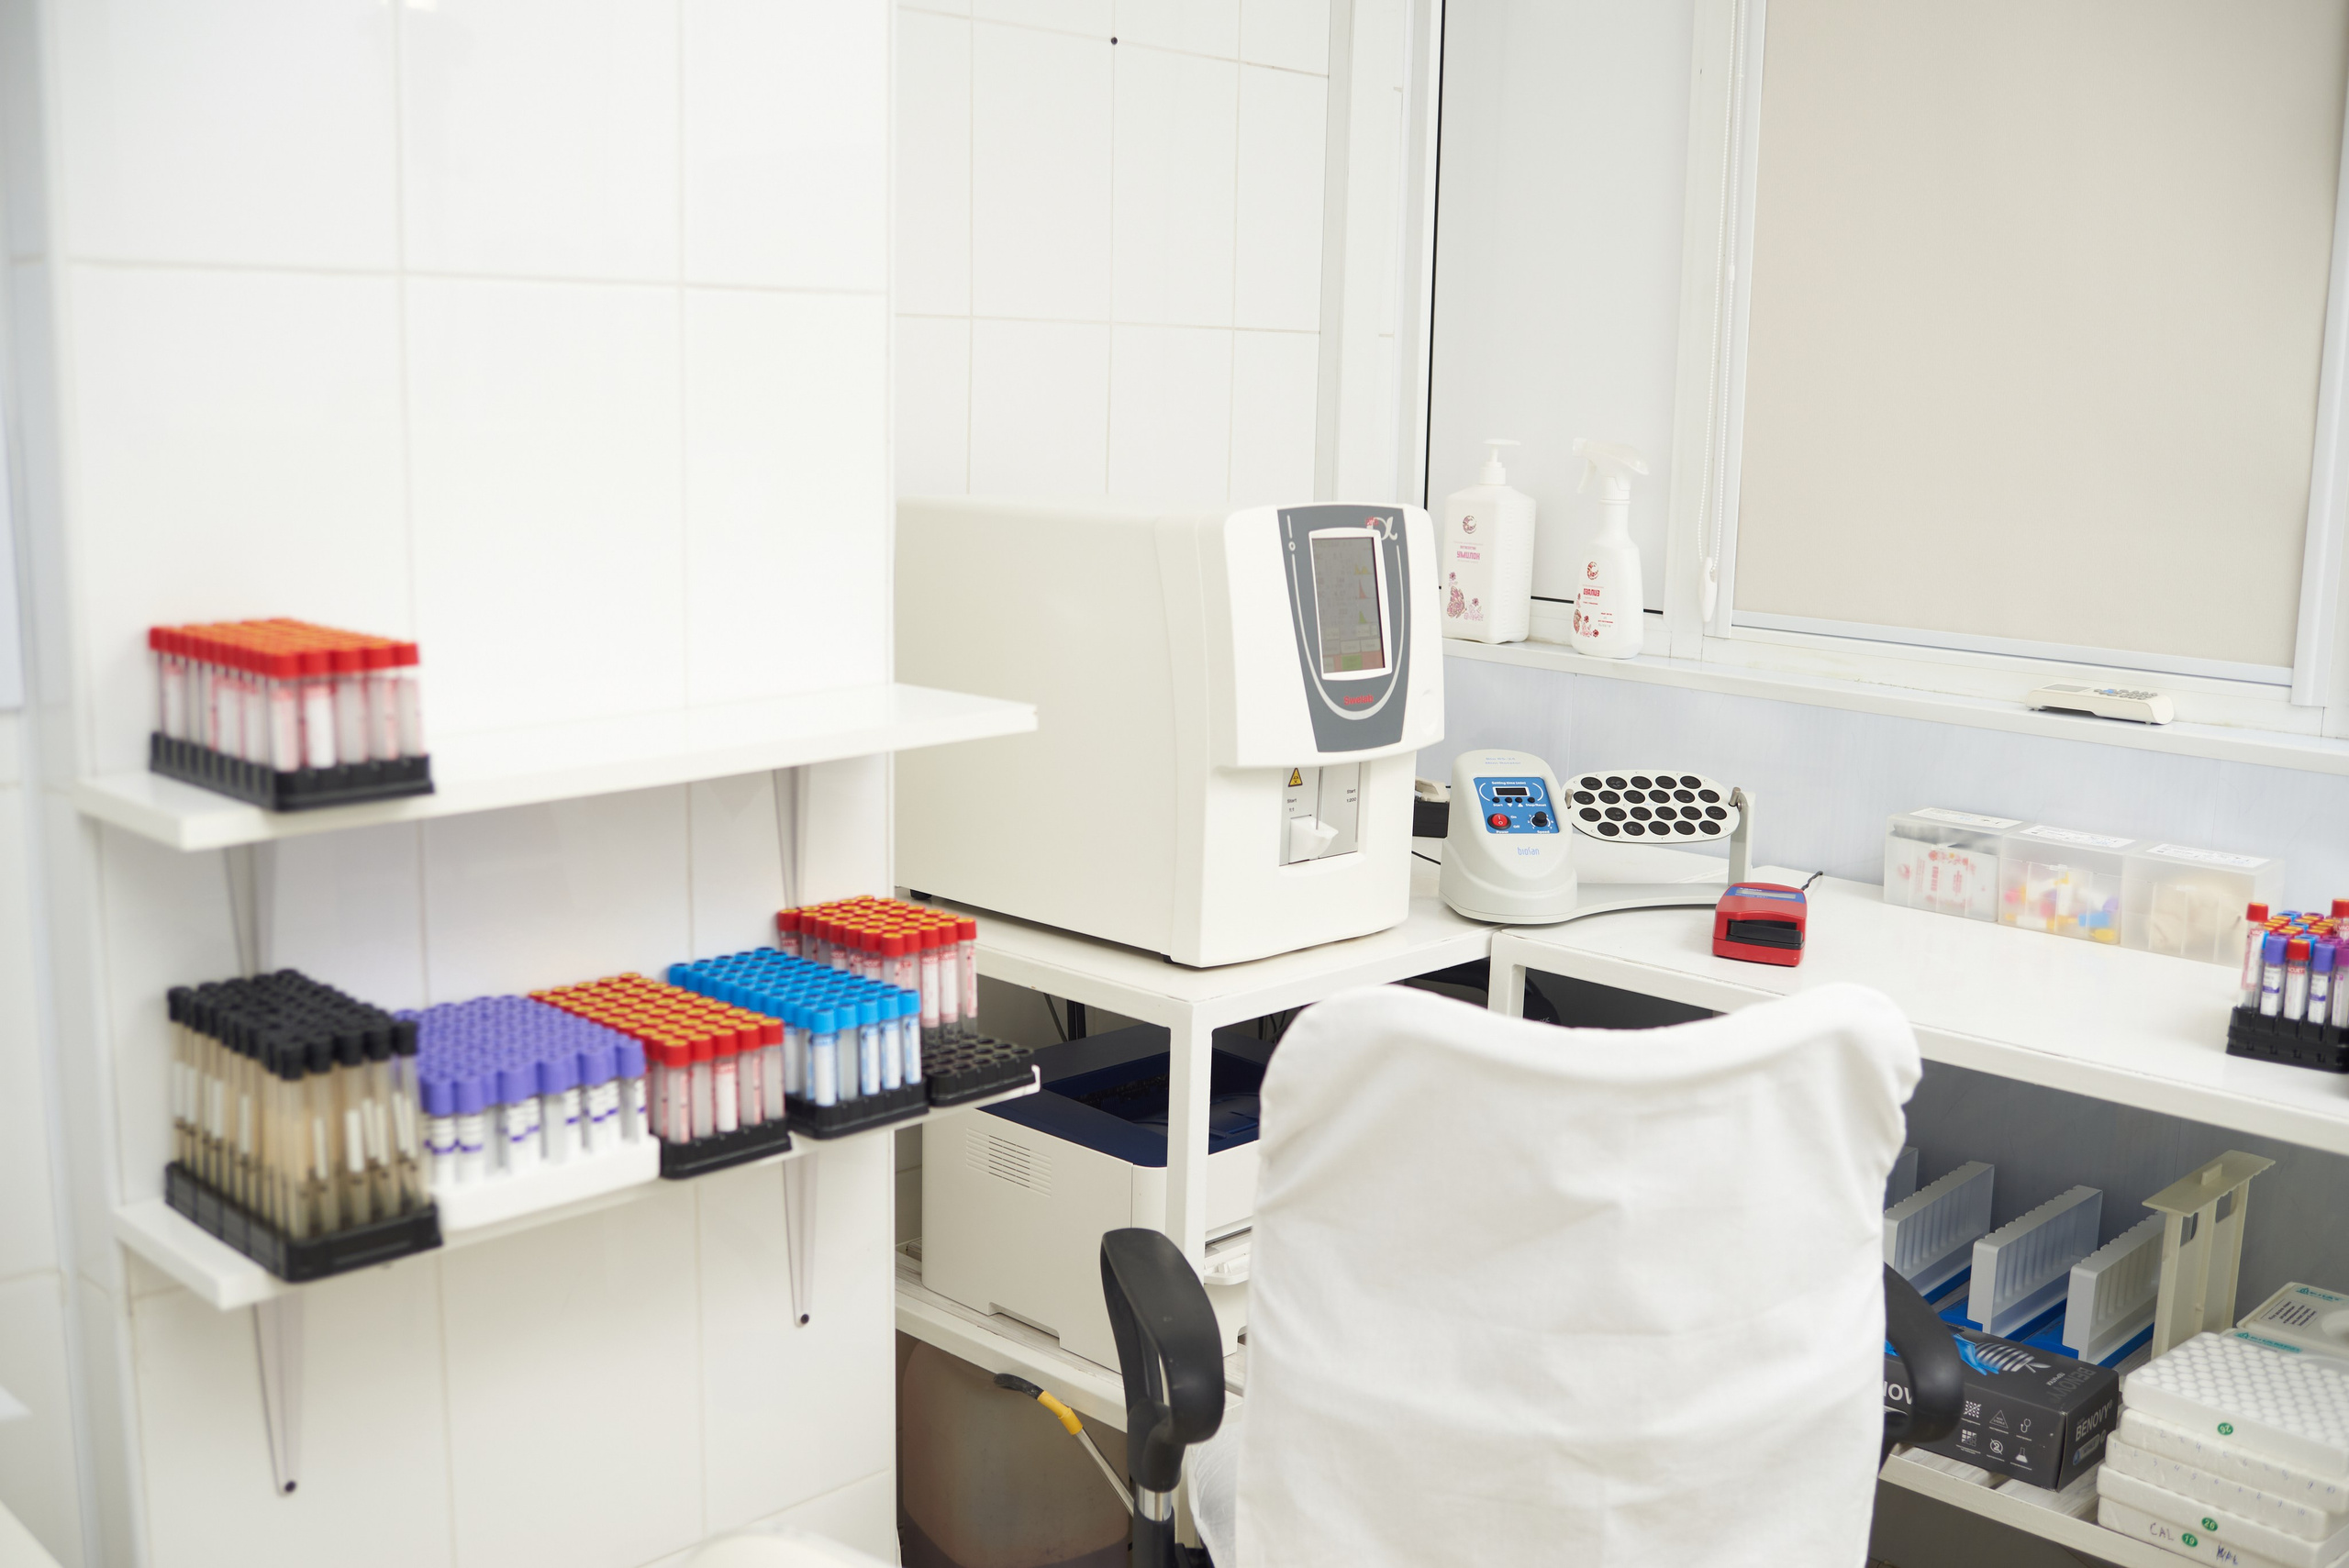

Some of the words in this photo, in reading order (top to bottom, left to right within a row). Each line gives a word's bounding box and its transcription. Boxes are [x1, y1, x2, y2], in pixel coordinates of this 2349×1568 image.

[1343, 694, 1374, 706] Swelab
[2204, 1519, 2215, 1529] 26
[2150, 1522, 2175, 1541] CAL
[2184, 1534, 2195, 1545] 19
